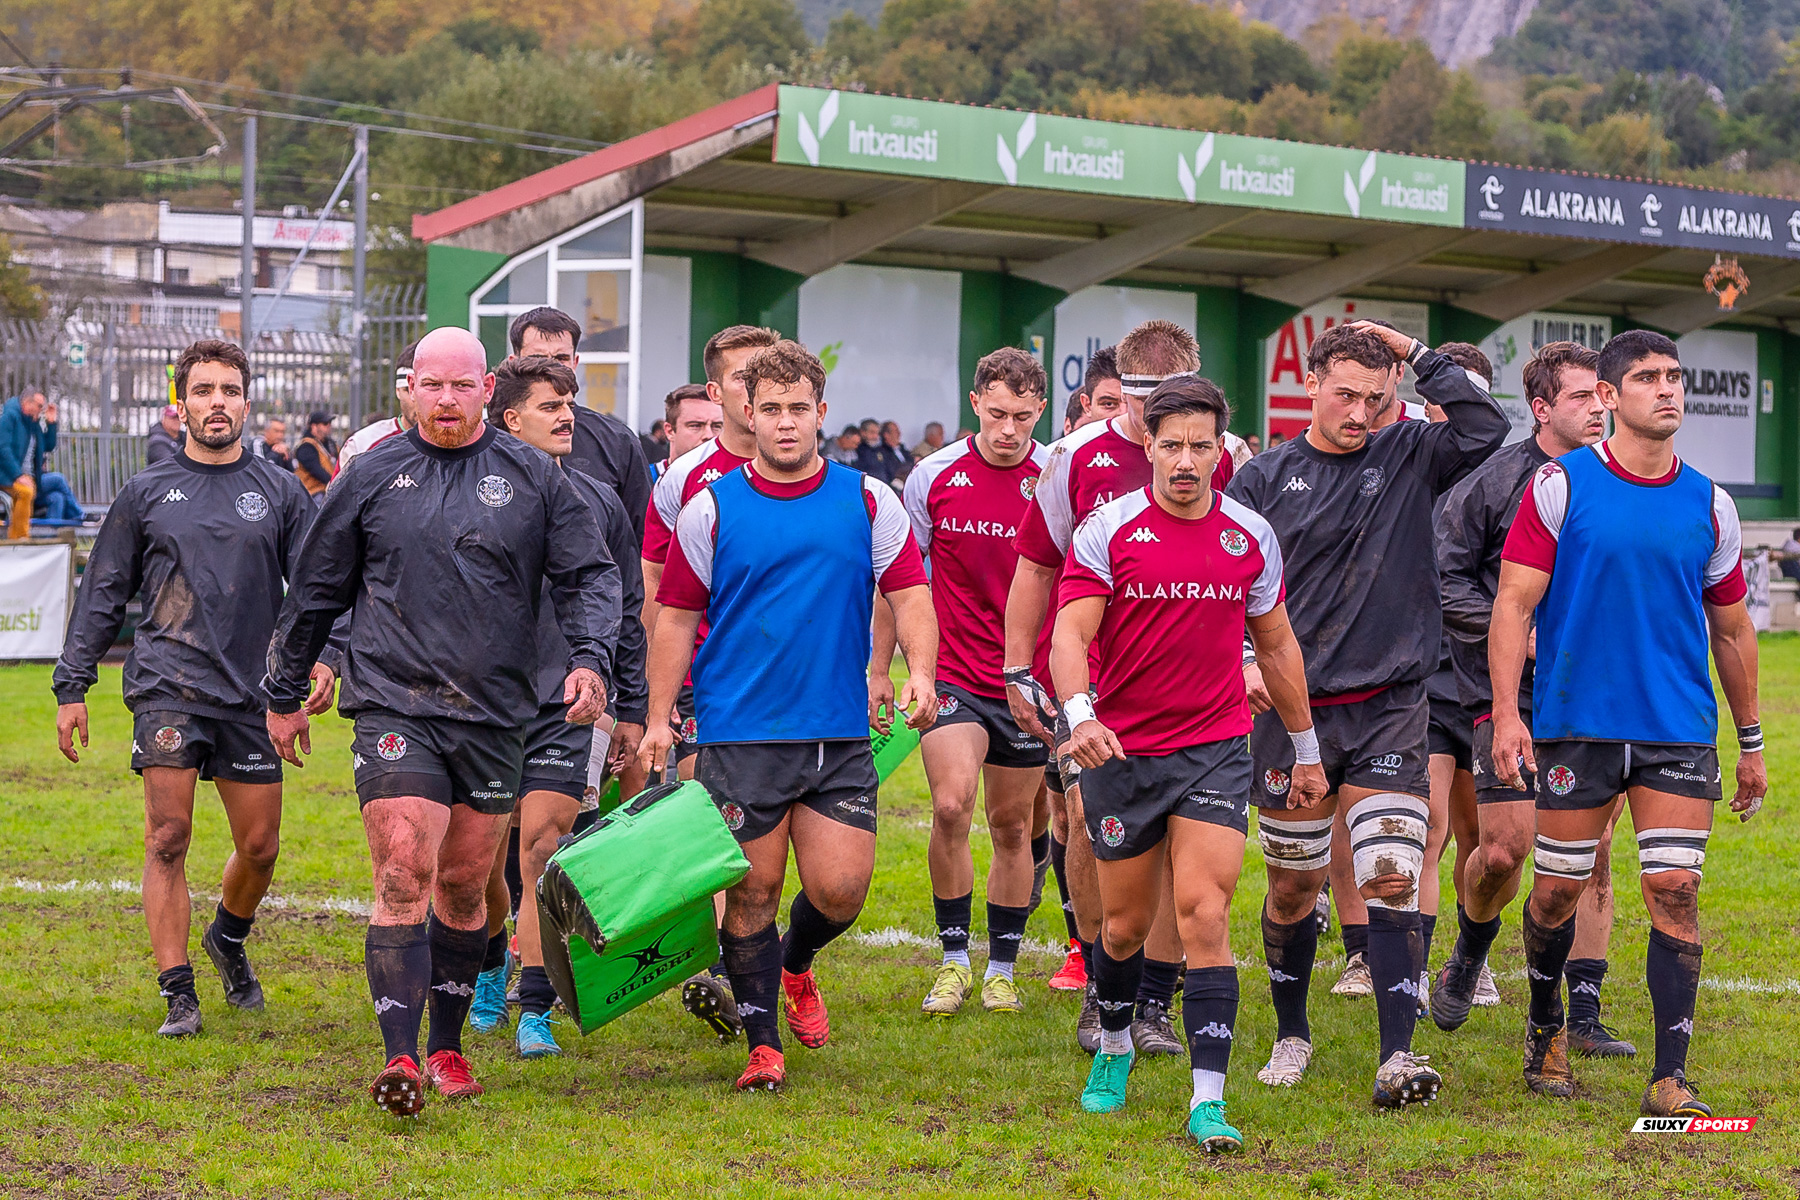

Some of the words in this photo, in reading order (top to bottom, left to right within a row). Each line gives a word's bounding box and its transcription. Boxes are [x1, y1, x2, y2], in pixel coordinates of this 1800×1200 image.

[849, 119, 938, 163] Intxausti
[1043, 141, 1125, 181] Intxausti
[1219, 159, 1295, 198] Intxausti
[1380, 176, 1449, 213] Intxausti
[1520, 187, 1626, 227] ALAKRANA
[1677, 204, 1774, 242] ALAKRANA
[1124, 581, 1243, 602] ALAKRANA
[550, 758, 575, 768] Gernika
[1371, 767, 1397, 775] Alzaga
[1659, 768, 1683, 780] Alzaga
[1209, 797, 1235, 810] Gernika
[605, 947, 695, 1005] GILBERT
